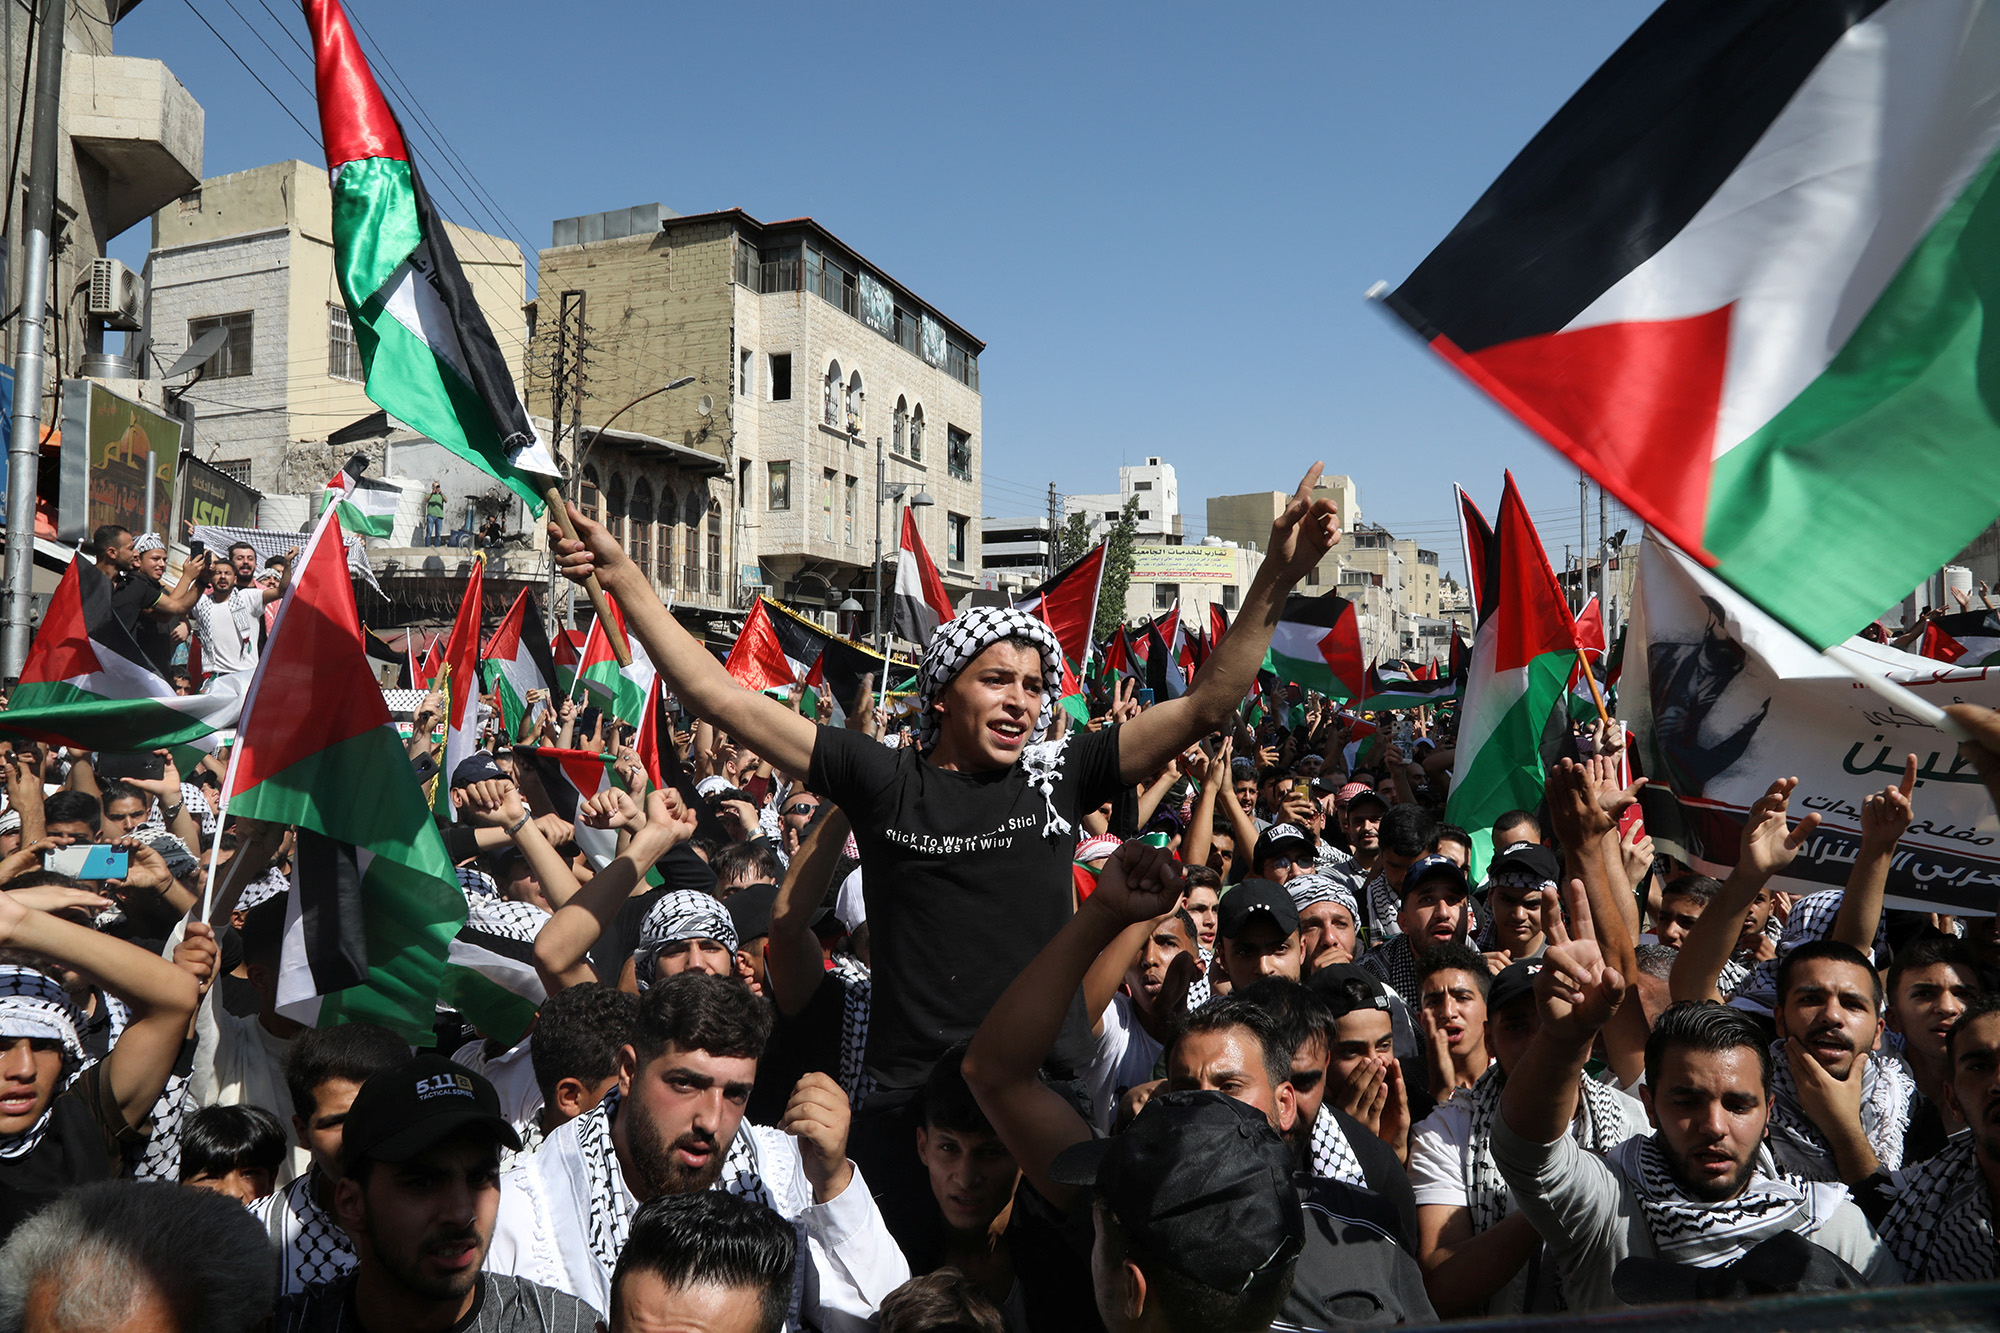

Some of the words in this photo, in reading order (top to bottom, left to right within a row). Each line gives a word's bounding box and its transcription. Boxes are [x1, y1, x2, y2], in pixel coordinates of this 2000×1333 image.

[1131, 549, 1166, 557] الجامعي
[884, 828, 918, 845] Stick
[922, 835, 938, 847] To
[416, 1073, 457, 1095] 5.11
[419, 1089, 453, 1101] TACTICAL
